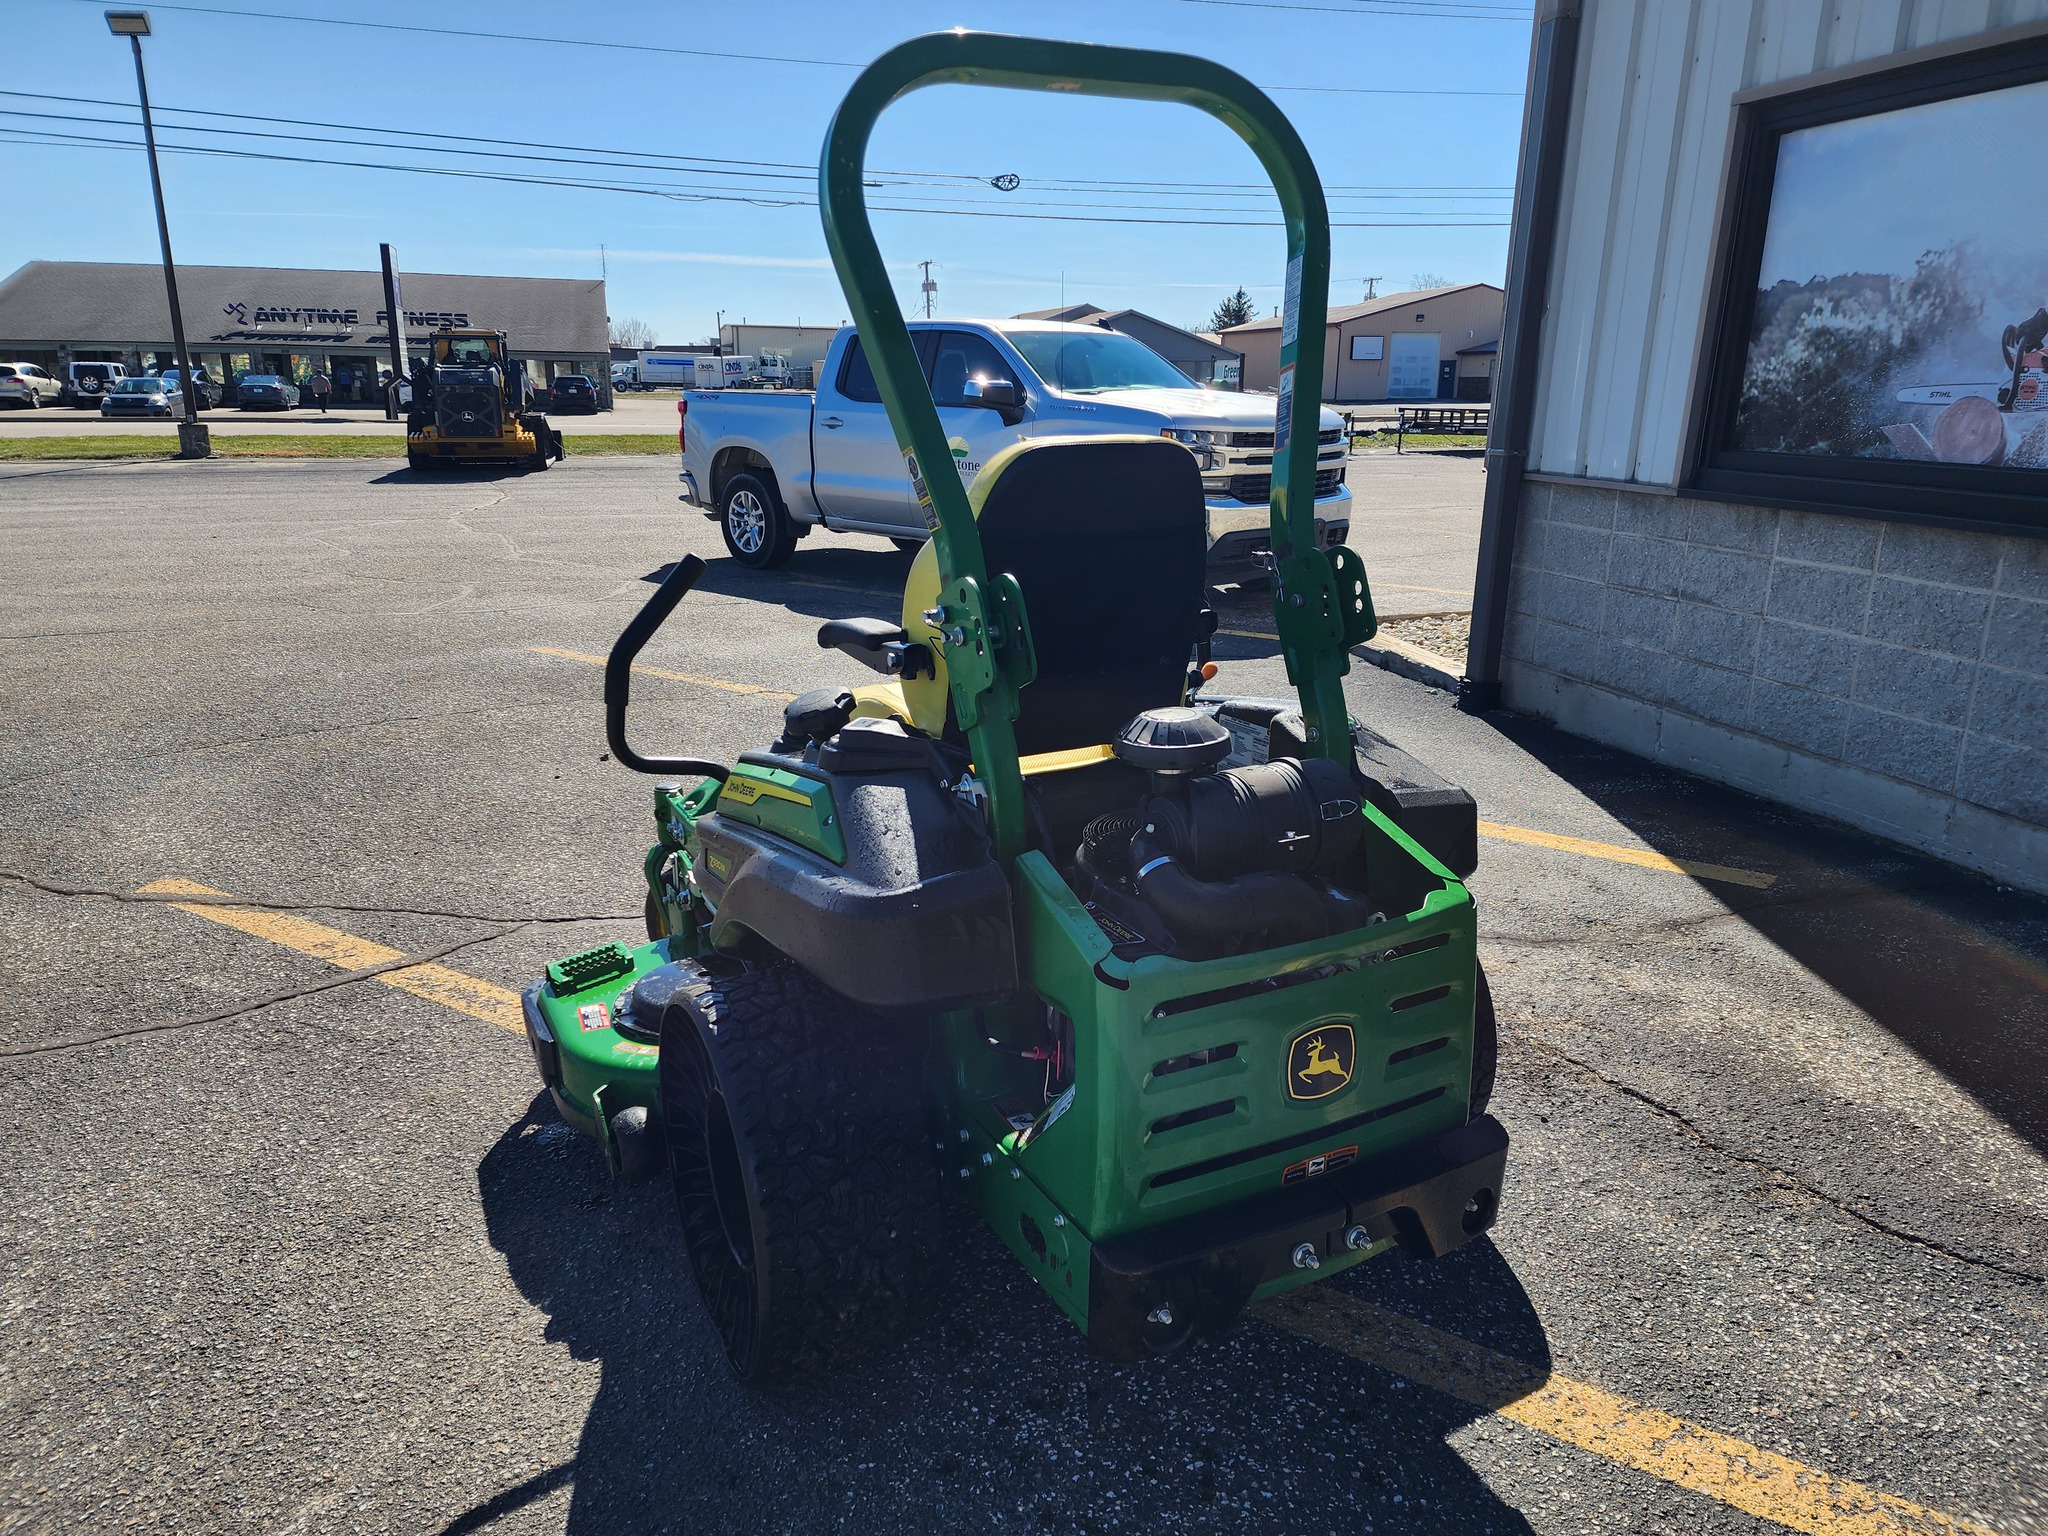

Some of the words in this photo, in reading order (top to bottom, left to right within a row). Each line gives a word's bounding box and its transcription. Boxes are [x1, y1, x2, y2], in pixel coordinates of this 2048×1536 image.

[254, 307, 359, 325] ANYTIME
[376, 310, 470, 329] FNESS
[957, 459, 980, 471] tone
[728, 780, 740, 793] JOHN
[740, 782, 756, 797] DEERE
[1113, 924, 1134, 940] DEERE
